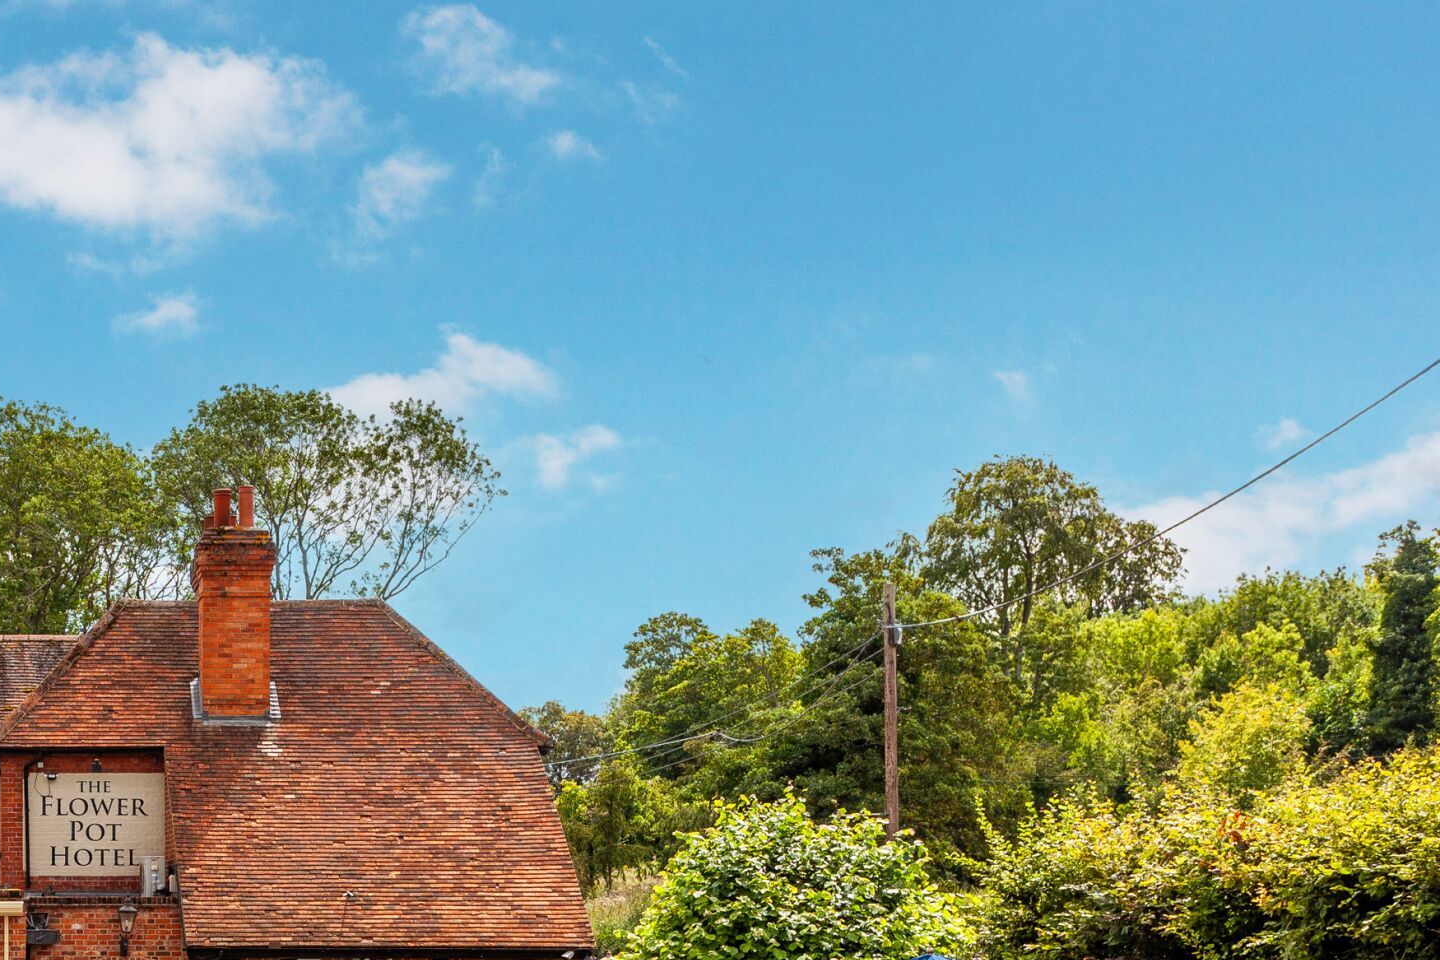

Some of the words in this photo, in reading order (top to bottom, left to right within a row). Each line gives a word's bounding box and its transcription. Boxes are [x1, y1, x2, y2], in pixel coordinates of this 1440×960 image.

[76, 780, 111, 793] THE
[40, 795, 148, 816] FLOWER
[69, 820, 122, 841] POT
[49, 846, 140, 867] HOTEL
